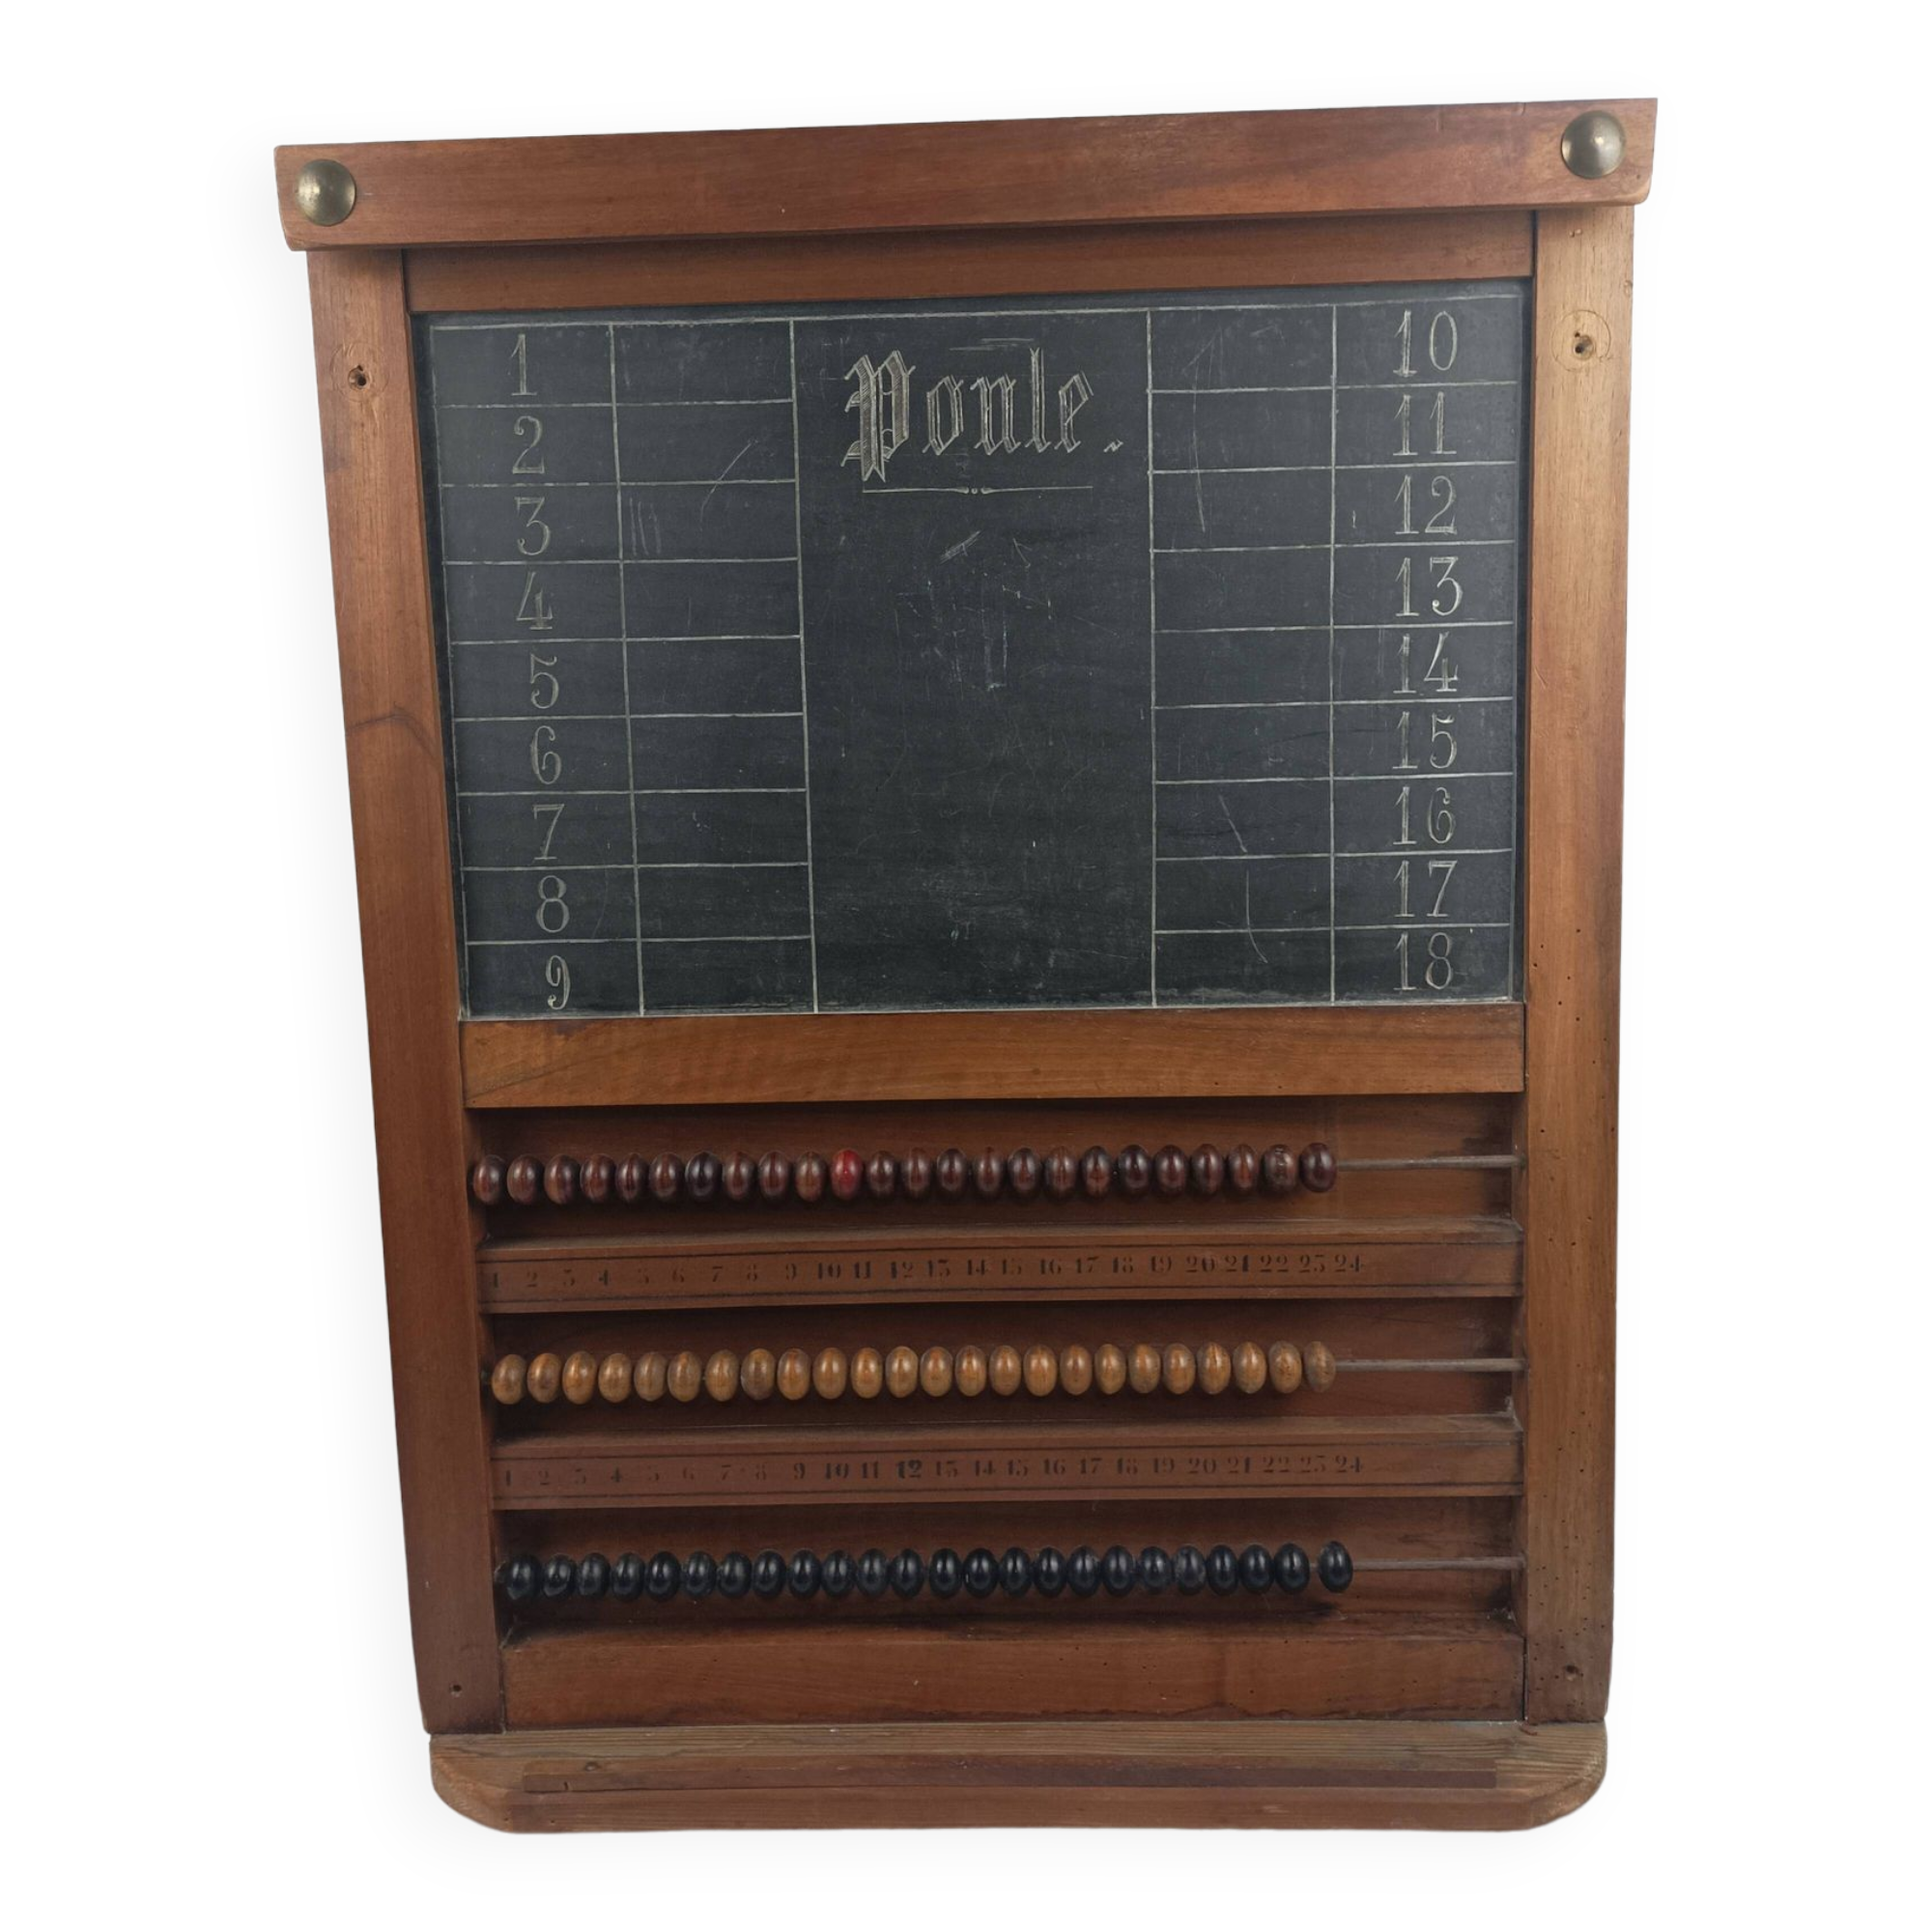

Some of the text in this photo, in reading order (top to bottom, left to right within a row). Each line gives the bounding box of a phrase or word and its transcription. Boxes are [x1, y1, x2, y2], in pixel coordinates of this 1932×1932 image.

[510, 333, 537, 396] 1
[1393, 310, 1458, 378] 10
[512, 415, 546, 474] 2
[1393, 391, 1457, 455] 11
[514, 497, 552, 555] 3
[1394, 474, 1458, 534] 12
[516, 571, 554, 631] 4
[1394, 555, 1463, 616] 13
[529, 653, 559, 709] 5
[1393, 633, 1459, 695] 14
[530, 724, 562, 784] 6
[1393, 710, 1458, 770] 15
[531, 803, 565, 861] 7
[1393, 785, 1456, 845] 16
[535, 874, 570, 933] 8
[1393, 859, 1458, 918] 17
[545, 954, 571, 1010] 9
[1393, 931, 1454, 991] 18
[598, 1269, 609, 1286] 4
[712, 1265, 724, 1282] 7
[747, 1264, 757, 1282] 8
[786, 1263, 797, 1280] 9
[818, 1263, 841, 1280] 10
[854, 1261, 871, 1279] 11
[891, 1262, 914, 1279] 12
[927, 1260, 951, 1277] 13
[967, 1259, 988, 1276] 14
[1039, 1259, 1062, 1275] 16
[1076, 1256, 1099, 1273] 17
[1186, 1256, 1215, 1272] 20
[1225, 1256, 1250, 1272] 21
[1260, 1255, 1289, 1272] 22
[1299, 1255, 1325, 1272] 23
[1334, 1255, 1364, 1272] 24
[611, 1467, 622, 1483] 4
[722, 1464, 731, 1480] 7
[793, 1463, 806, 1480] 9
[826, 1463, 849, 1480] 10
[862, 1462, 879, 1479] 11
[896, 1460, 923, 1479] 12
[975, 1461, 995, 1477] 14
[1044, 1459, 1065, 1475] 16
[1080, 1458, 1102, 1474] 17
[1153, 1458, 1175, 1473] 19
[1187, 1458, 1216, 1474] 20
[1227, 1457, 1251, 1474] 21
[1264, 1457, 1290, 1473] 22
[1300, 1456, 1325, 1473] 23
[1335, 1455, 1363, 1473] 24
